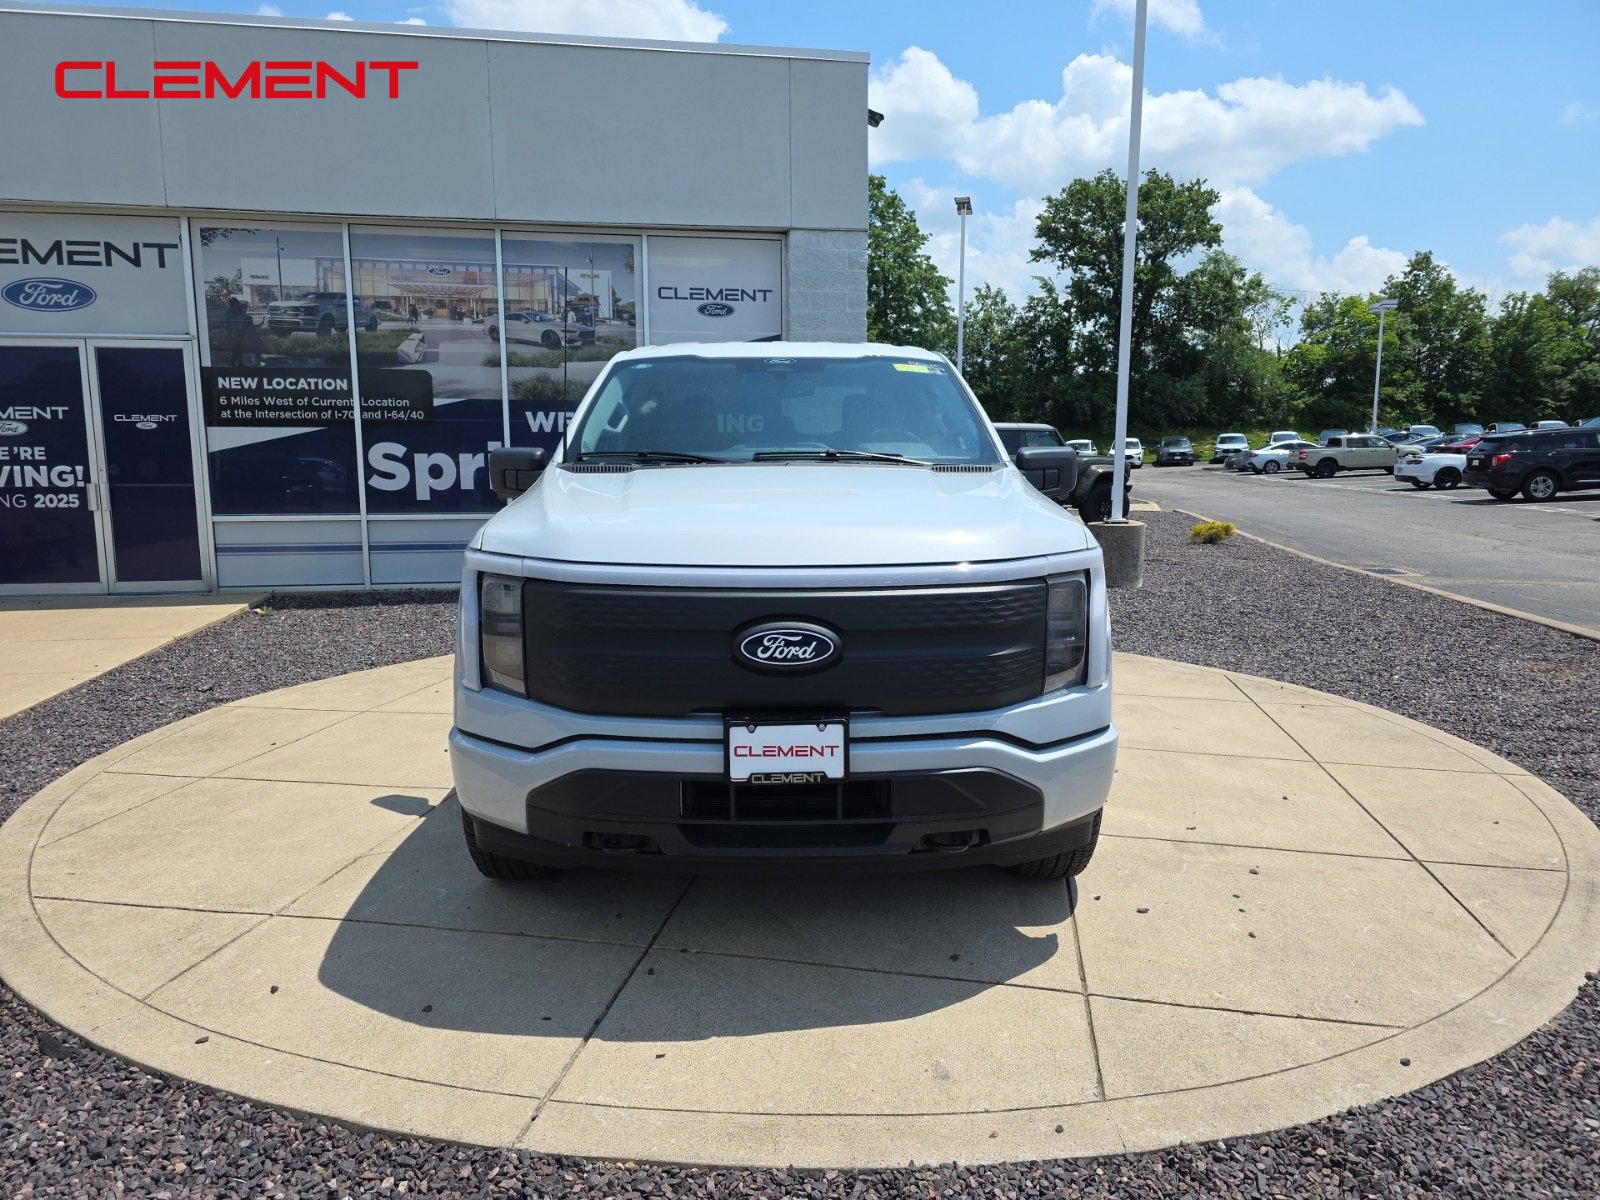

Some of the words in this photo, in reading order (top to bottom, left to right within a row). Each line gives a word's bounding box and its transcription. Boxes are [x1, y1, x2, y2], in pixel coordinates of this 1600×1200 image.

[19, 282, 79, 306] Ford
[658, 286, 773, 302] CLEMENT
[704, 305, 728, 316] Ford
[217, 376, 259, 389] NEW
[262, 377, 349, 390] LOCATION
[219, 396, 228, 405] 6
[230, 396, 260, 406] Miles
[263, 396, 294, 406] West
[296, 397, 309, 406] of
[311, 397, 355, 407] Current
[361, 397, 410, 407] Location
[113, 414, 178, 422] CLEMENT
[220, 409, 232, 418] at
[234, 409, 252, 418] the
[255, 409, 318, 419] Intersection
[320, 409, 332, 419] of
[334, 410, 355, 419] I-70
[362, 410, 382, 419] and
[384, 410, 425, 421] I-64/40
[34, 493, 80, 508] 2025
[757, 634, 817, 659] Ford
[734, 745, 840, 758] CLEMENT
[751, 773, 825, 785] CLEMENT
